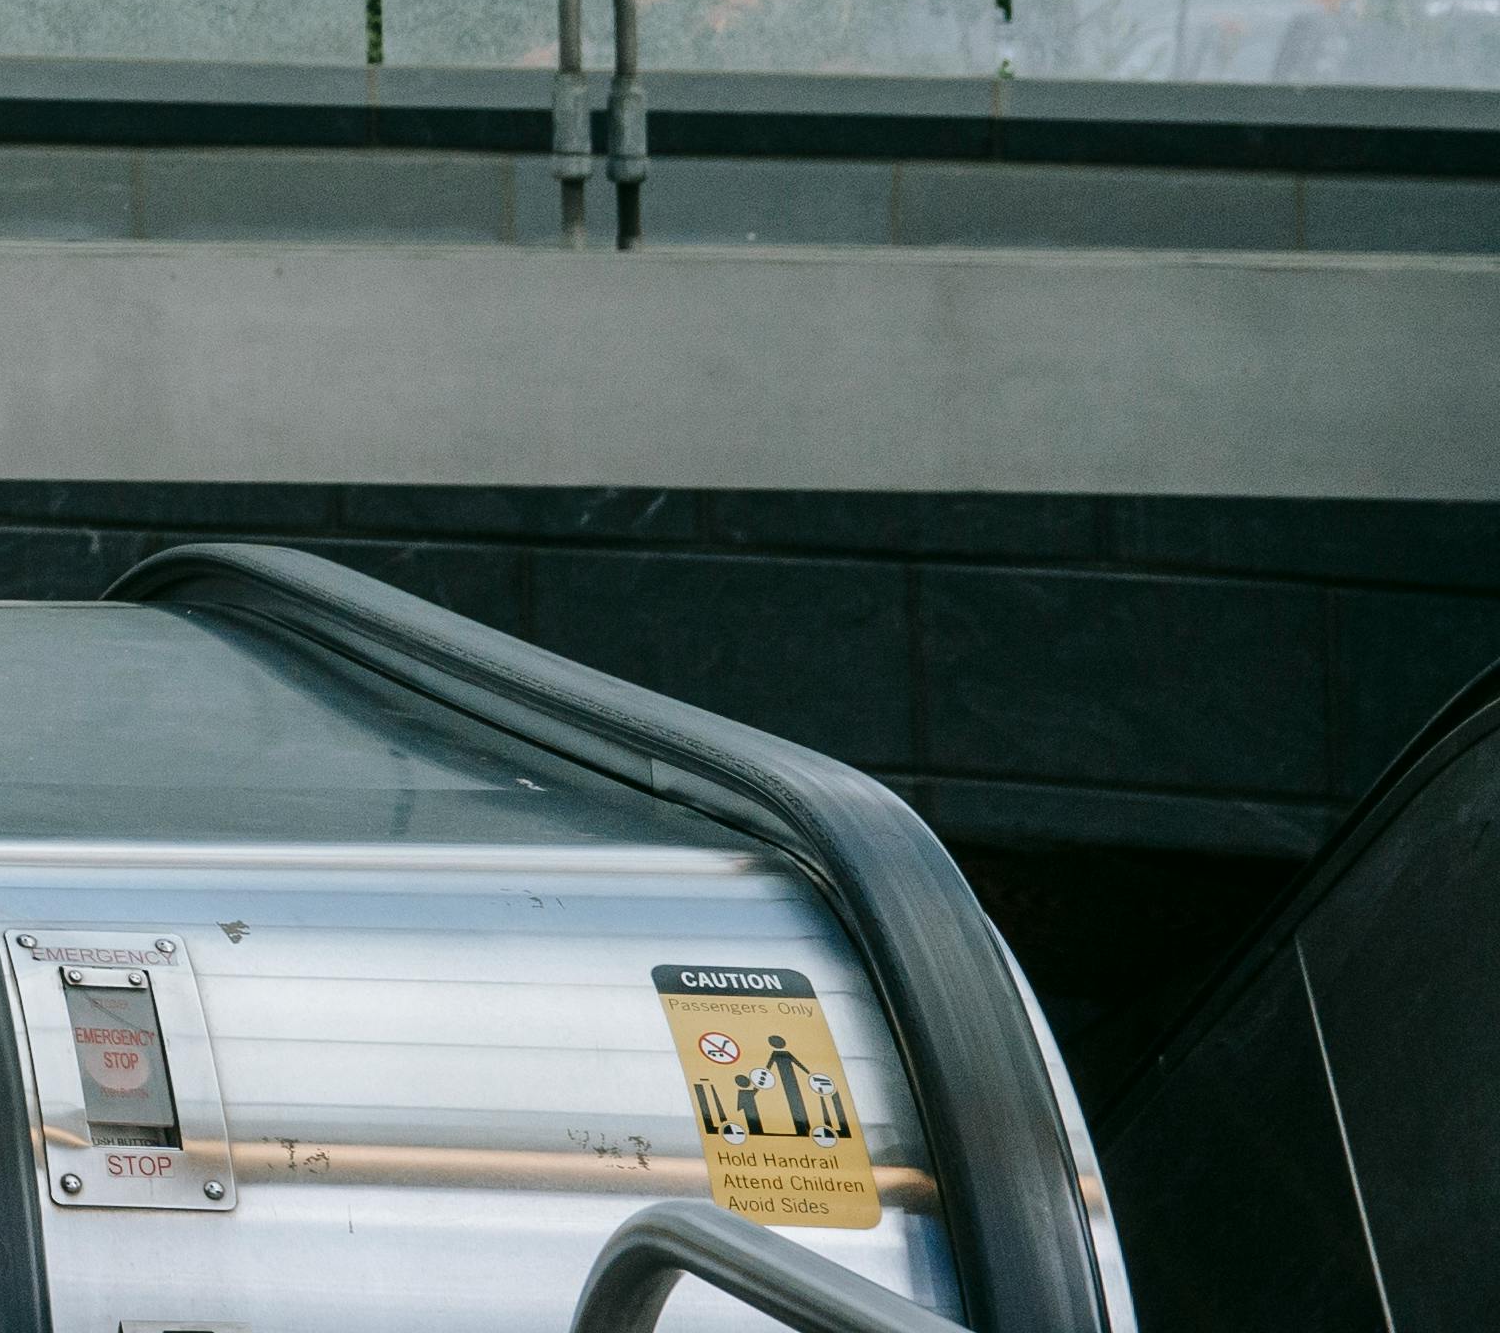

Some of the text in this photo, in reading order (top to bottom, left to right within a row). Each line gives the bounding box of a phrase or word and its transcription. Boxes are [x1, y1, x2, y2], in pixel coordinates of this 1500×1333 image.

[32, 948, 174, 966] EMERGENCY
[681, 971, 783, 990] CAUTION
[668, 998, 814, 1018] Passengers Only
[74, 1027, 155, 1046] EMERGENCY
[103, 1052, 139, 1070] STOP
[107, 1155, 172, 1176] STOP
[717, 1151, 839, 1170] Hold Handrail
[724, 1174, 865, 1193] Attend Children
[728, 1195, 830, 1214] Avoid Sides
